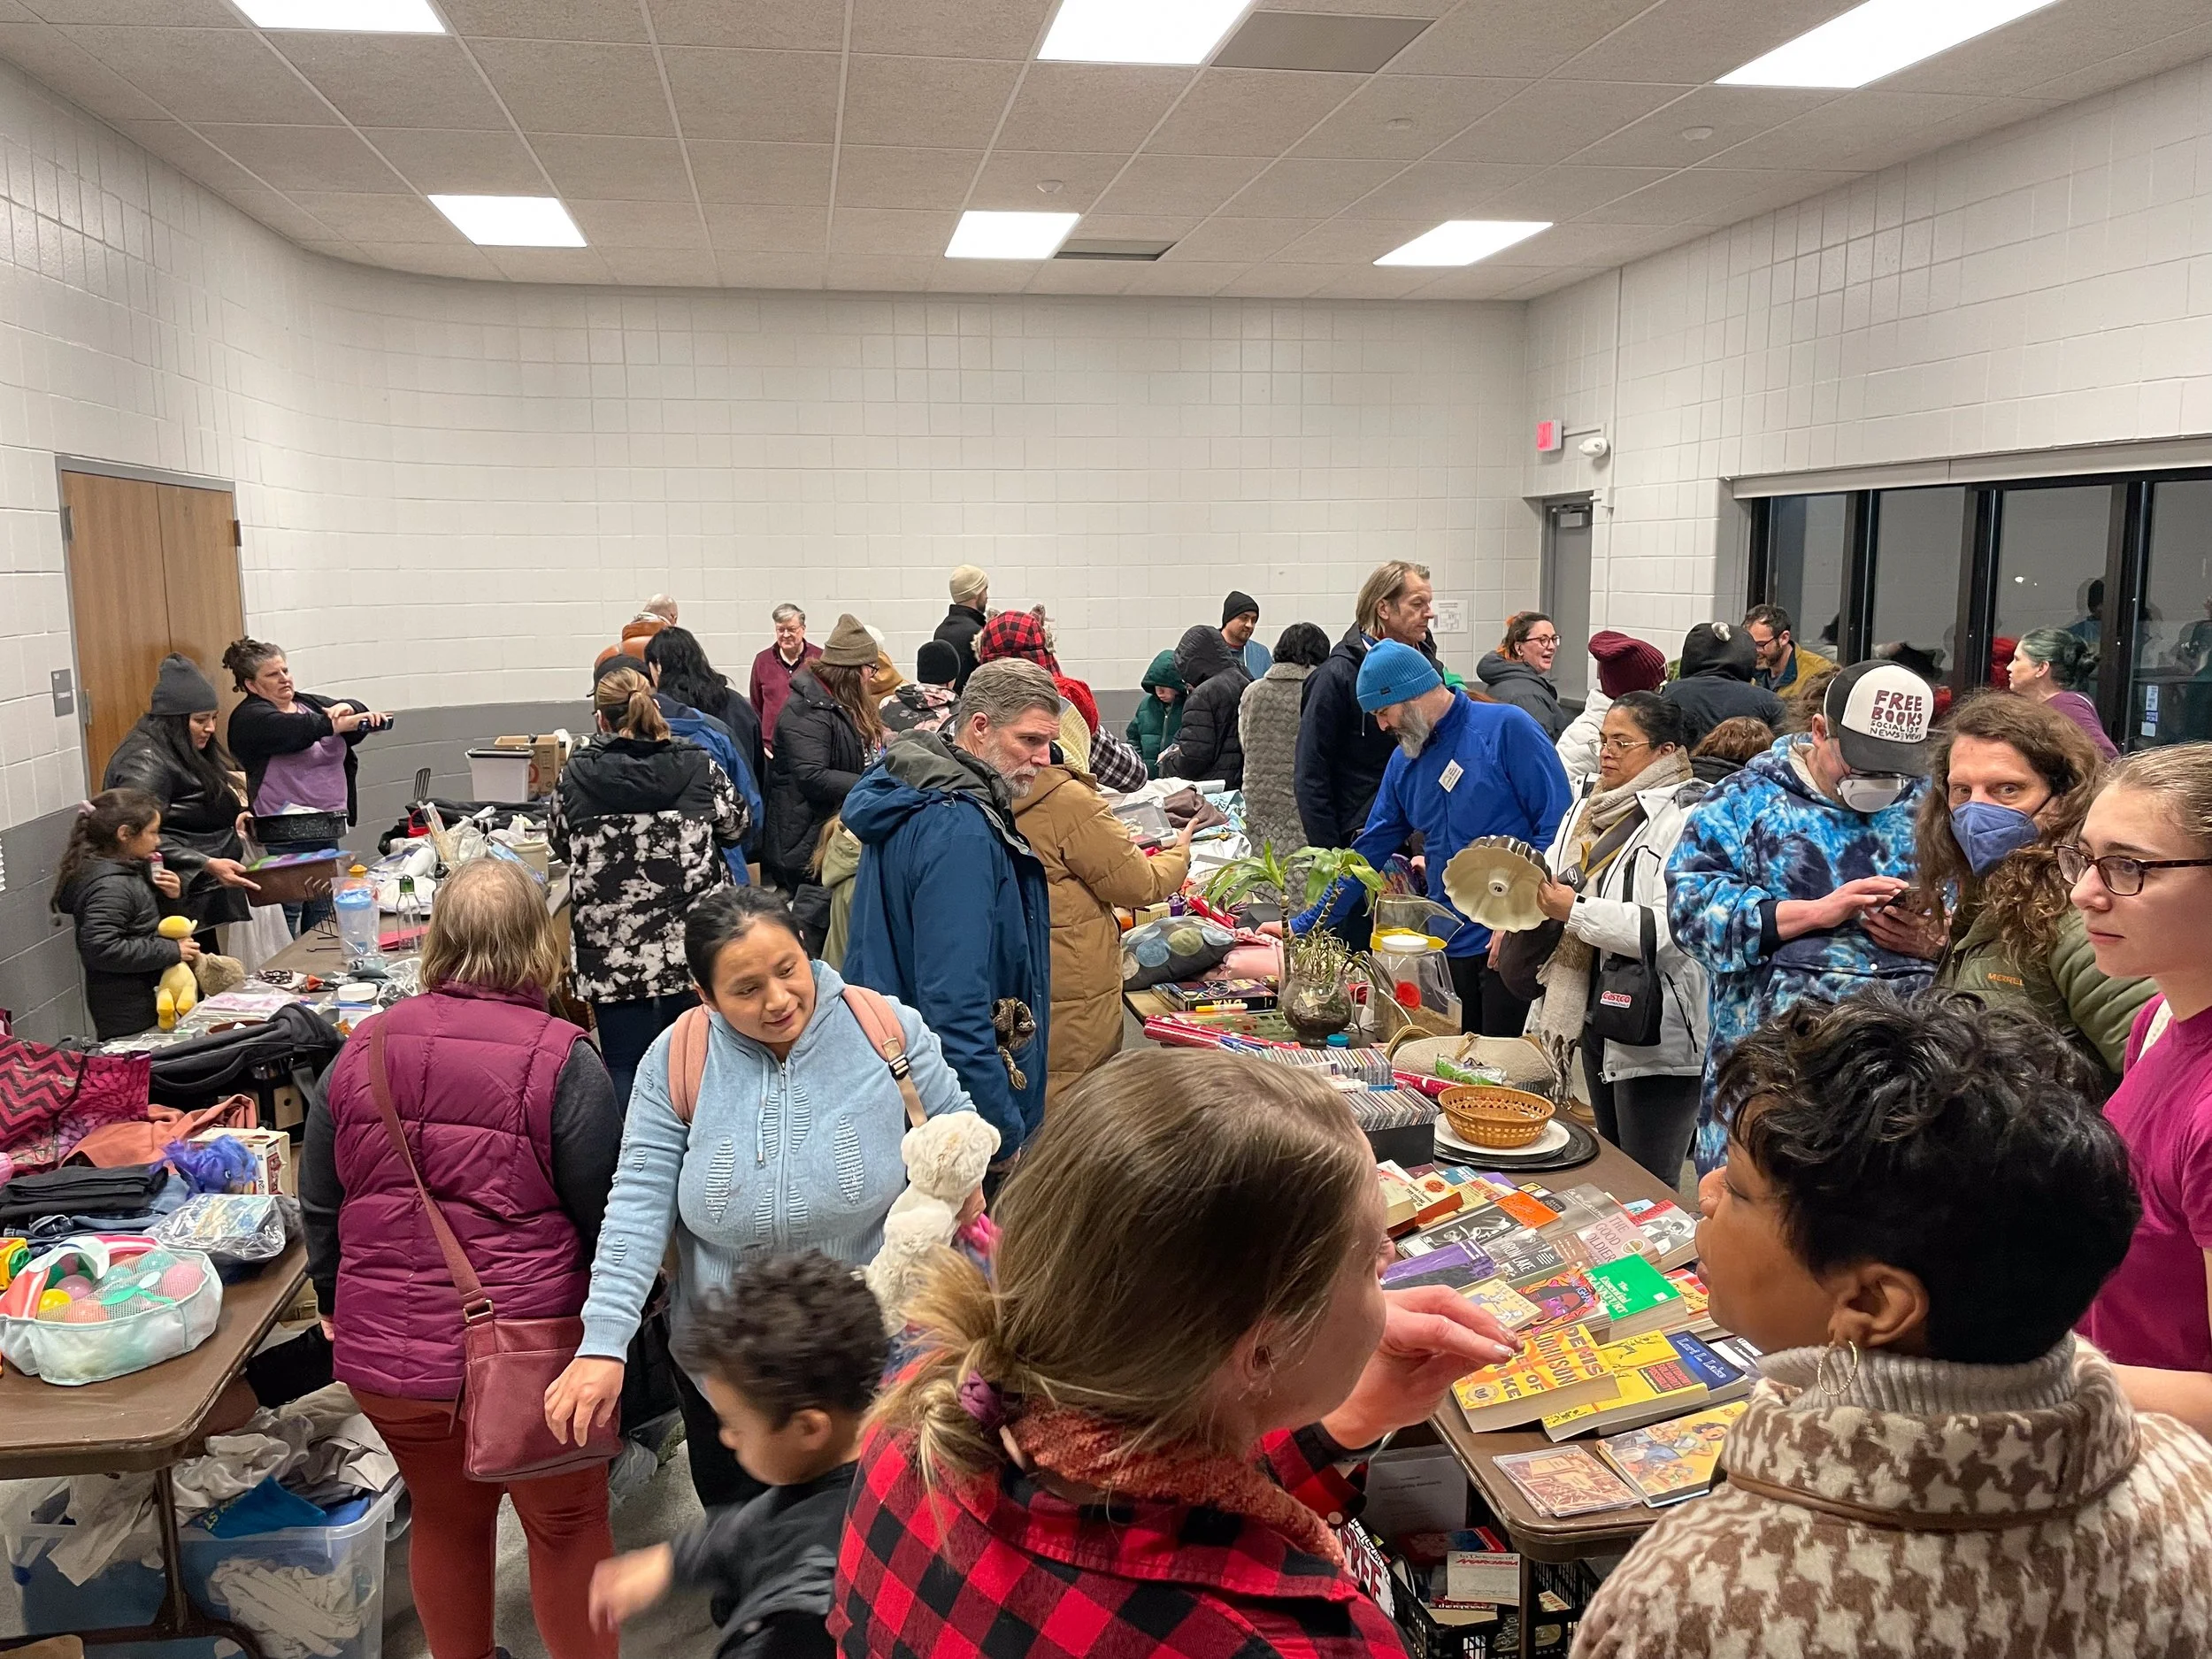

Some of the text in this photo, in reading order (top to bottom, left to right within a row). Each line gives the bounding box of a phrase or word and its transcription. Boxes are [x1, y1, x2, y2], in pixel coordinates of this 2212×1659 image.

[1875, 690, 1923, 711] FREE
[1870, 720, 1919, 733] SOCIALIST
[1871, 707, 1923, 727] BOOKS
[1870, 727, 1900, 738] NEWS
[1602, 992, 1631, 1003] COSTCO
[1595, 1219, 1622, 1247] GOOD
[1608, 1216, 1630, 1233] THE
[1499, 1240, 1522, 1263] IRON
[1511, 1255, 1536, 1273] LAKE
[1586, 1233, 1617, 1263] OLDIER
[1599, 1275, 1632, 1304] Essential
[1617, 1280, 1630, 1293] The
[1533, 1334, 1579, 1386] JOHNSON
[1563, 1326, 1605, 1377] DENIS
[1676, 1337, 1701, 1356] Lori
[1703, 1359, 1727, 1379] Lake
[1525, 1373, 1545, 1391] OF
